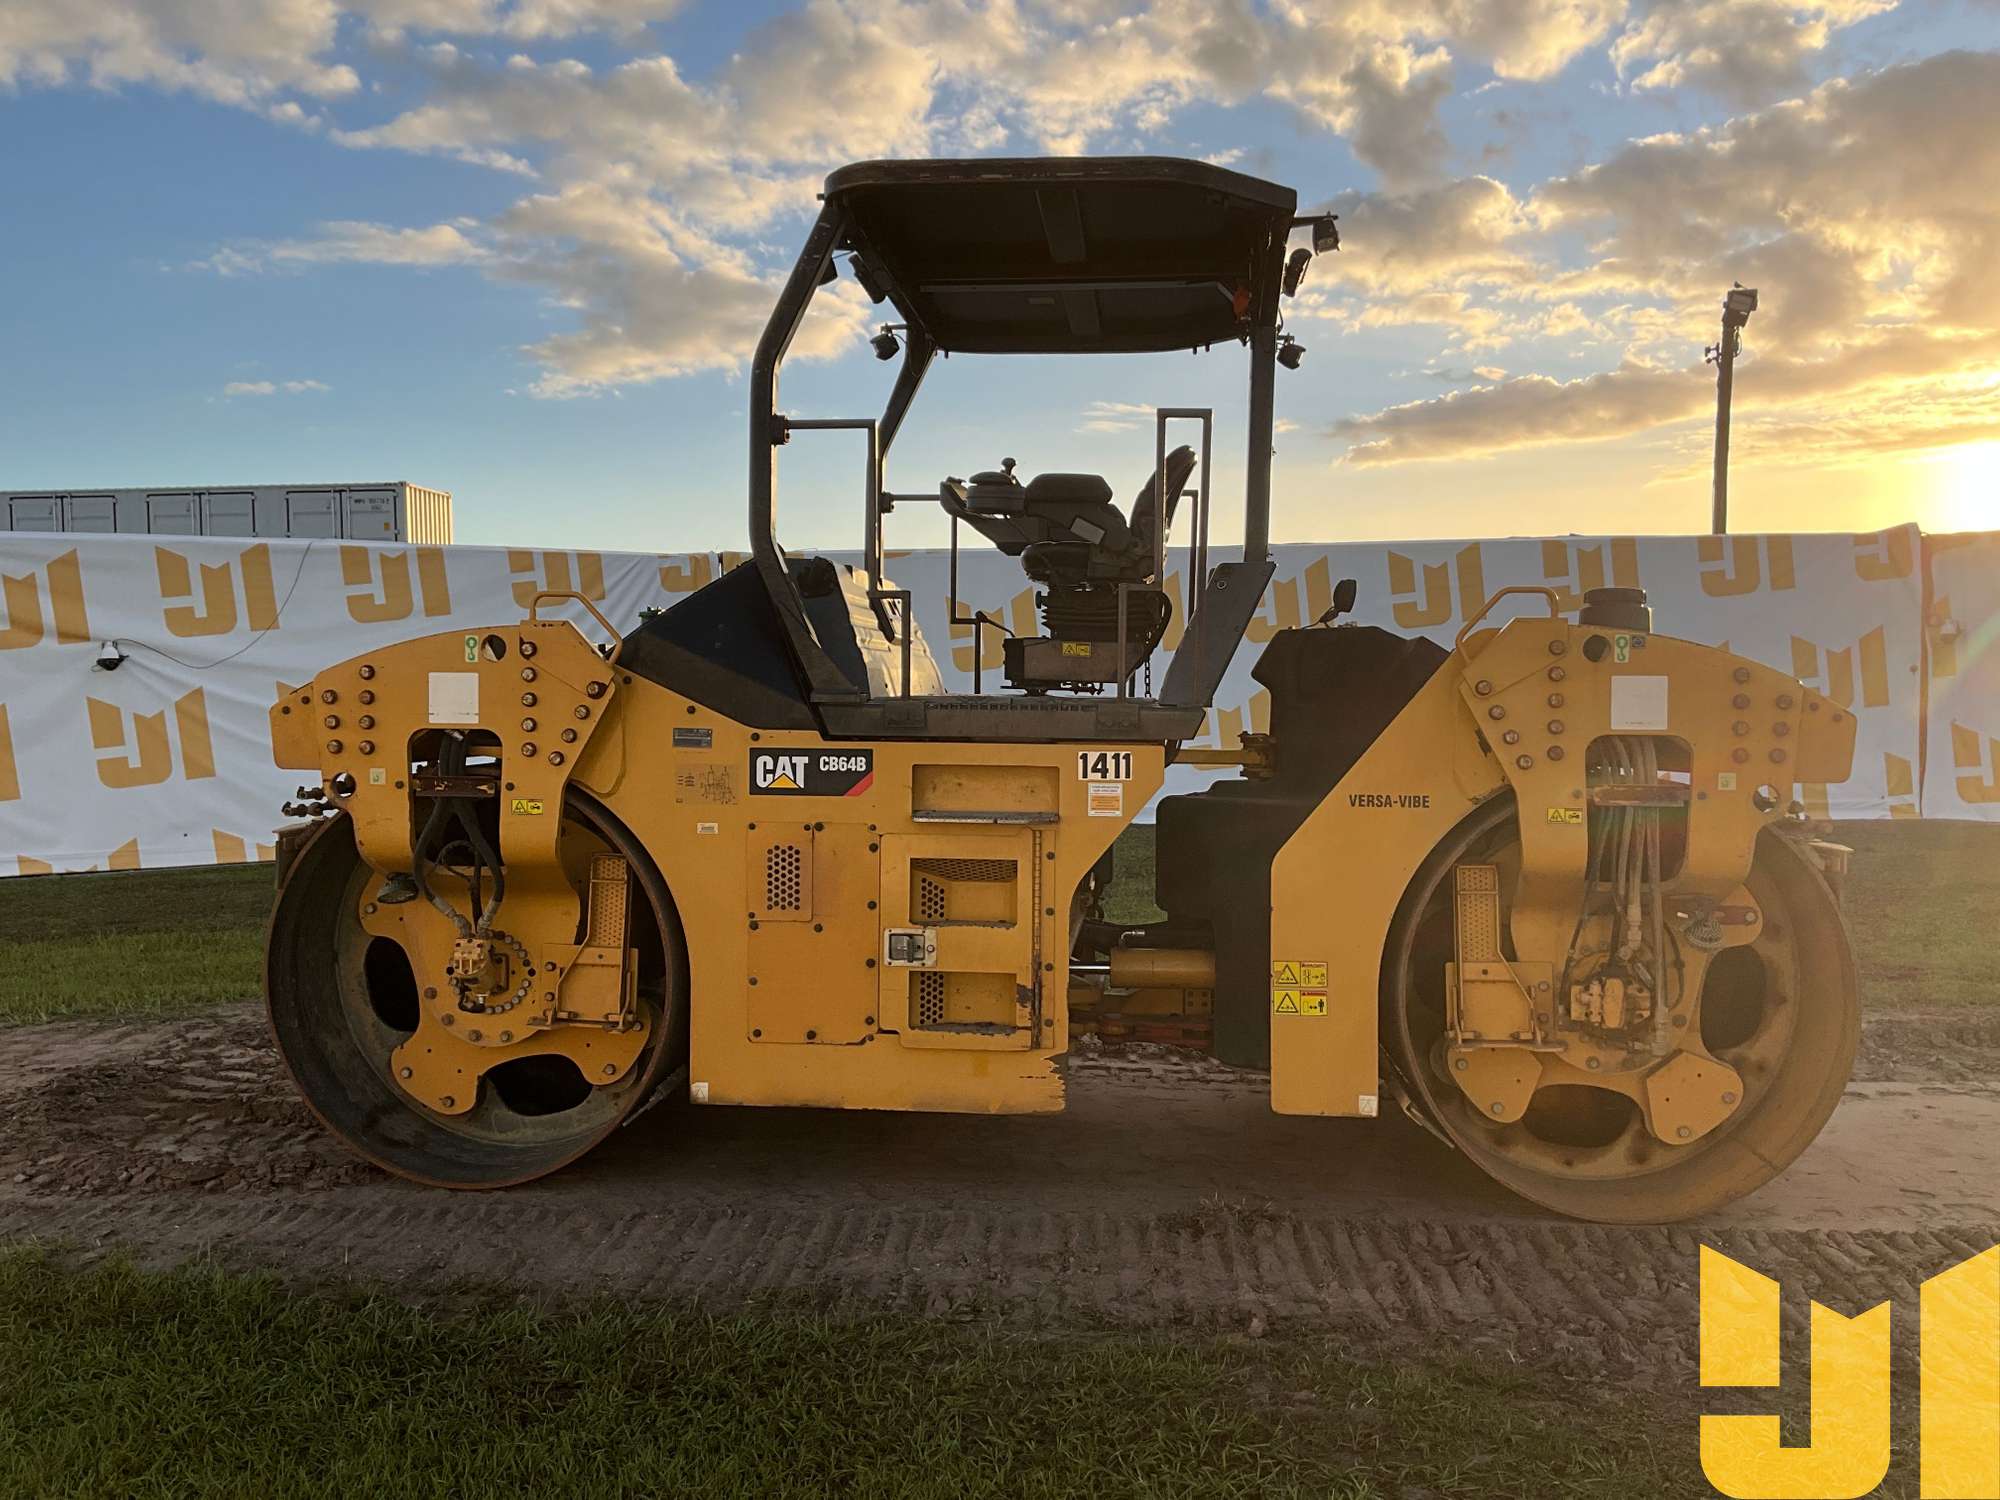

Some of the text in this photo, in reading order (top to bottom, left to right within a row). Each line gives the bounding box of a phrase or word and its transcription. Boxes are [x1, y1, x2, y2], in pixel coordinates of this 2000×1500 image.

[756, 755, 867, 789] CAT CB64B
[1079, 752, 1132, 779] 1411
[1349, 794, 1430, 809] VERSA-VIBE
